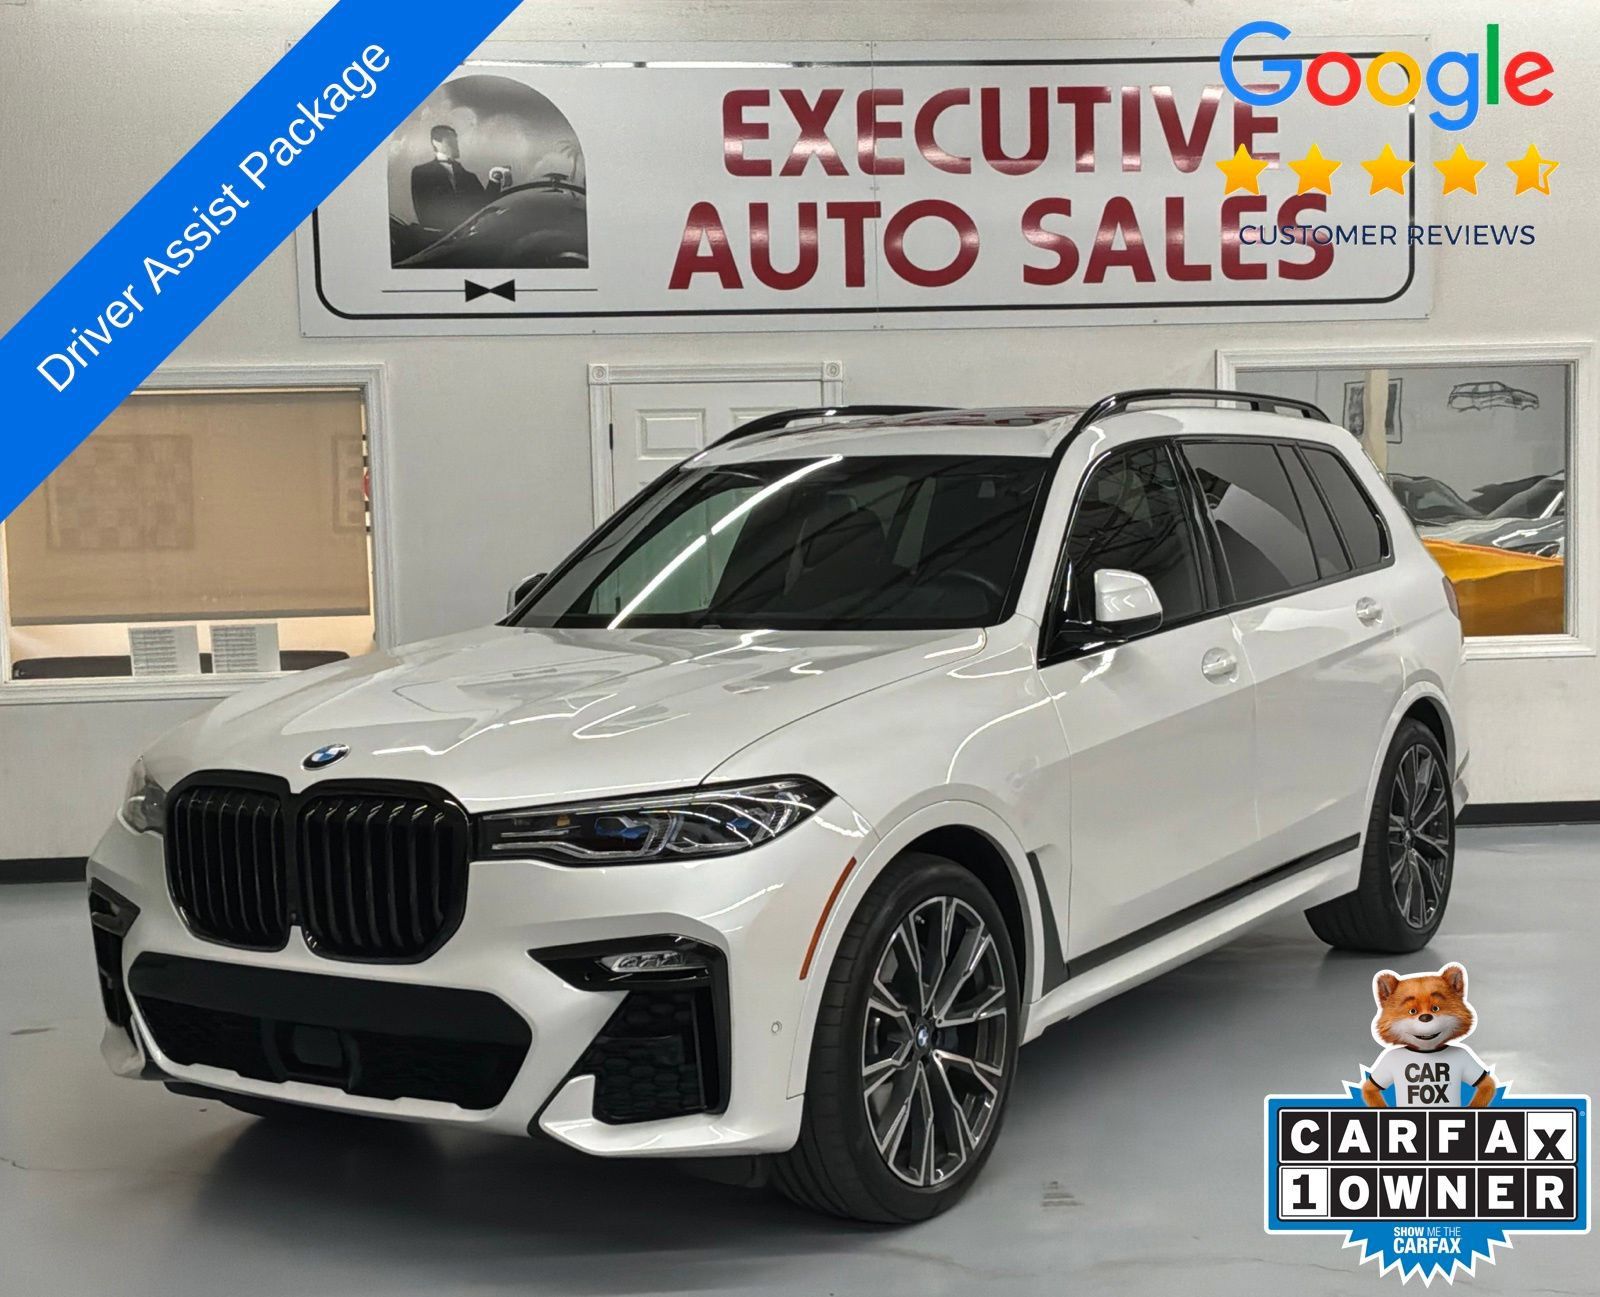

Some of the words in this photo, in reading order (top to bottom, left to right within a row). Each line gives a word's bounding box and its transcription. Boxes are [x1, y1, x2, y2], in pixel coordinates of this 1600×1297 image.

[722, 85, 1280, 177] EXECUTIVE
[668, 198, 980, 290] AUTO
[1022, 192, 1335, 285] SALES
